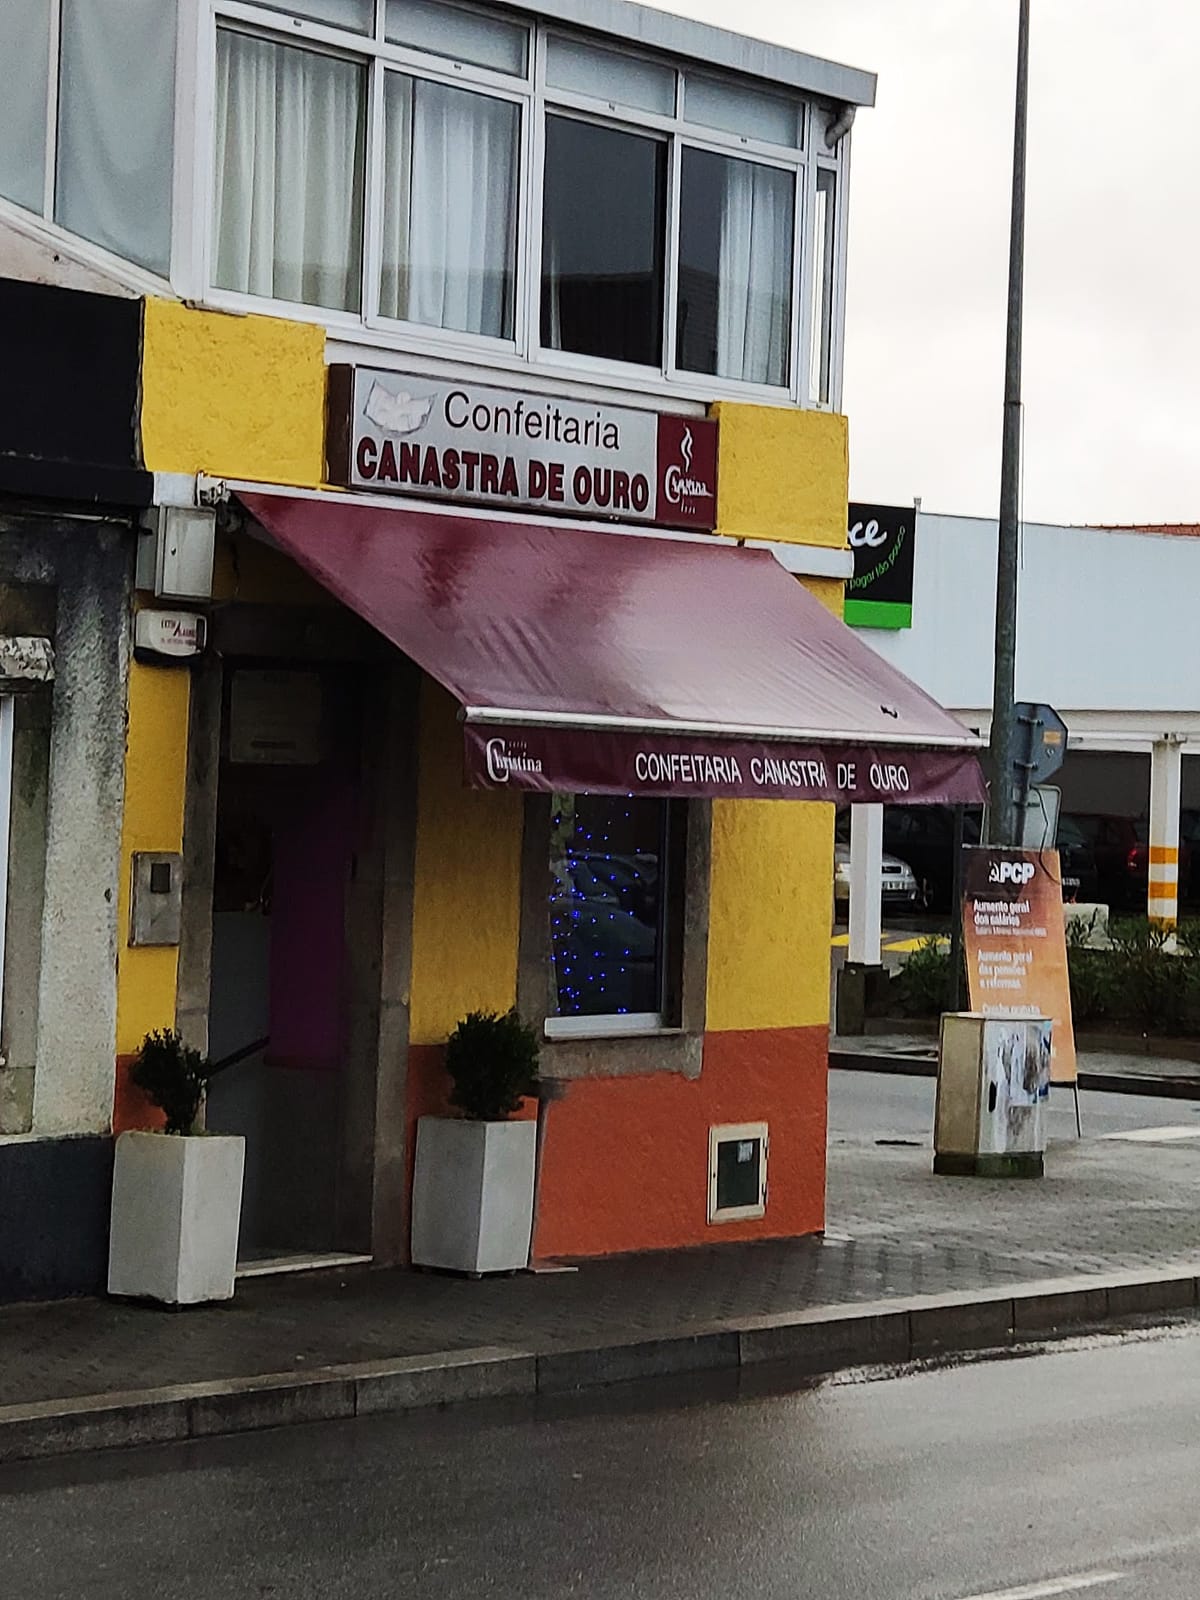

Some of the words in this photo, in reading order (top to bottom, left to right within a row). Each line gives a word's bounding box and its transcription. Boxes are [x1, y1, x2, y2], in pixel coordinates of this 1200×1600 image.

[444, 391, 620, 450] Confeitaria
[356, 436, 520, 497] CANASTRA
[528, 460, 565, 501] DE
[573, 465, 650, 513] OURO
[486, 738, 543, 783] Christina
[634, 752, 742, 784] CONFEITARIA
[750, 757, 827, 788] CANASTRA
[836, 763, 858, 790] DE
[869, 765, 910, 792] OURO
[1000, 862, 1035, 884] PCP
[974, 899, 1009, 912] Aumento
